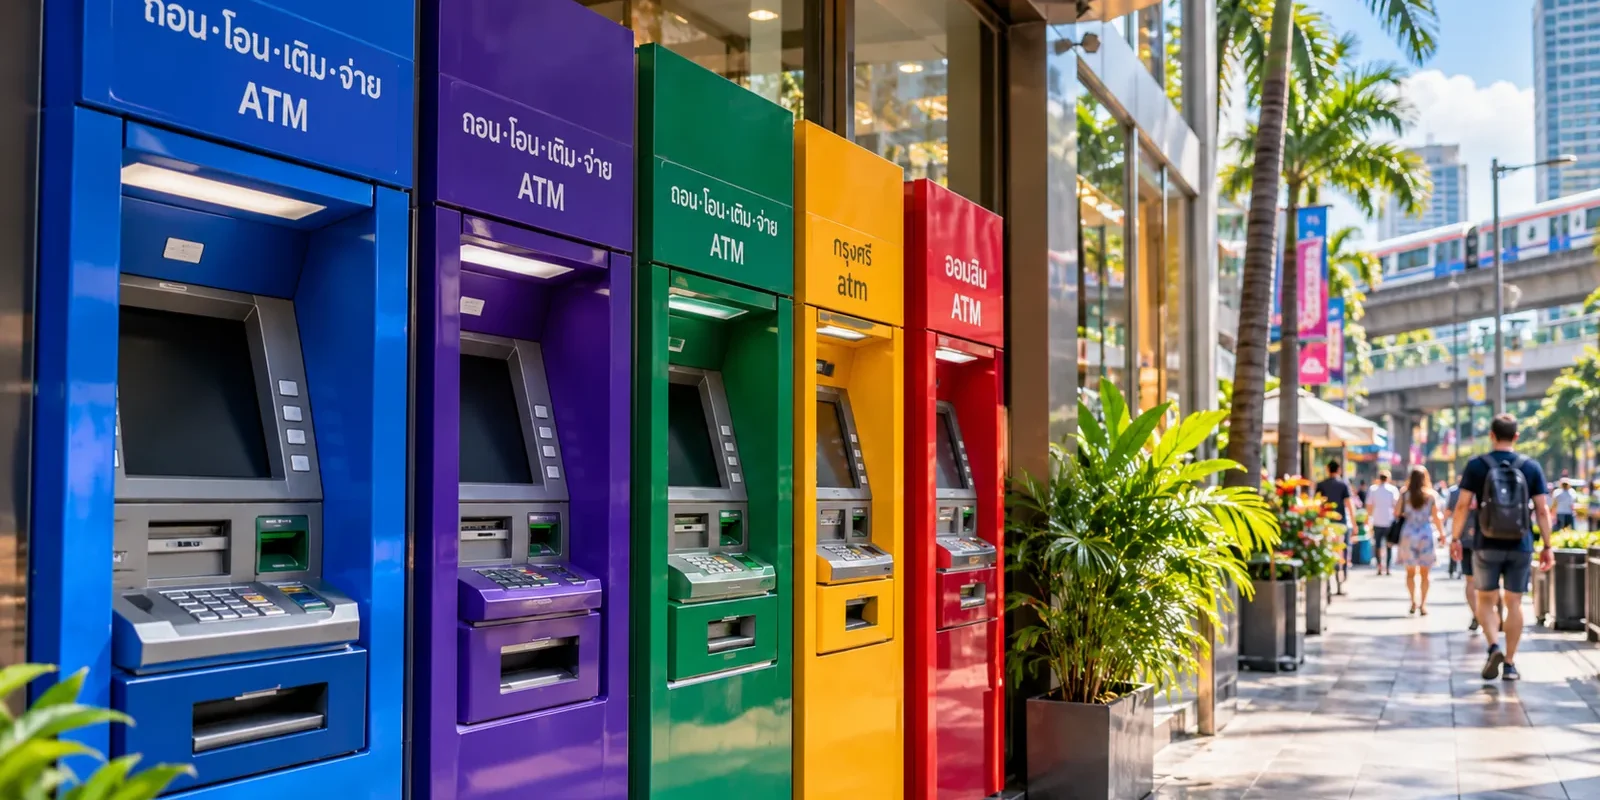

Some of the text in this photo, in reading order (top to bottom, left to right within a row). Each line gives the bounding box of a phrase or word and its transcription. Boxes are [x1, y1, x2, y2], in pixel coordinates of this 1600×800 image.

[238, 81, 308, 132] ATM
[517, 172, 564, 212] ATM
[709, 233, 744, 266] ATM
[833, 238, 872, 267] กรุงศรี
[837, 272, 868, 302] atm
[945, 254, 988, 289] ออมสิน
[950, 292, 982, 327] ATM
